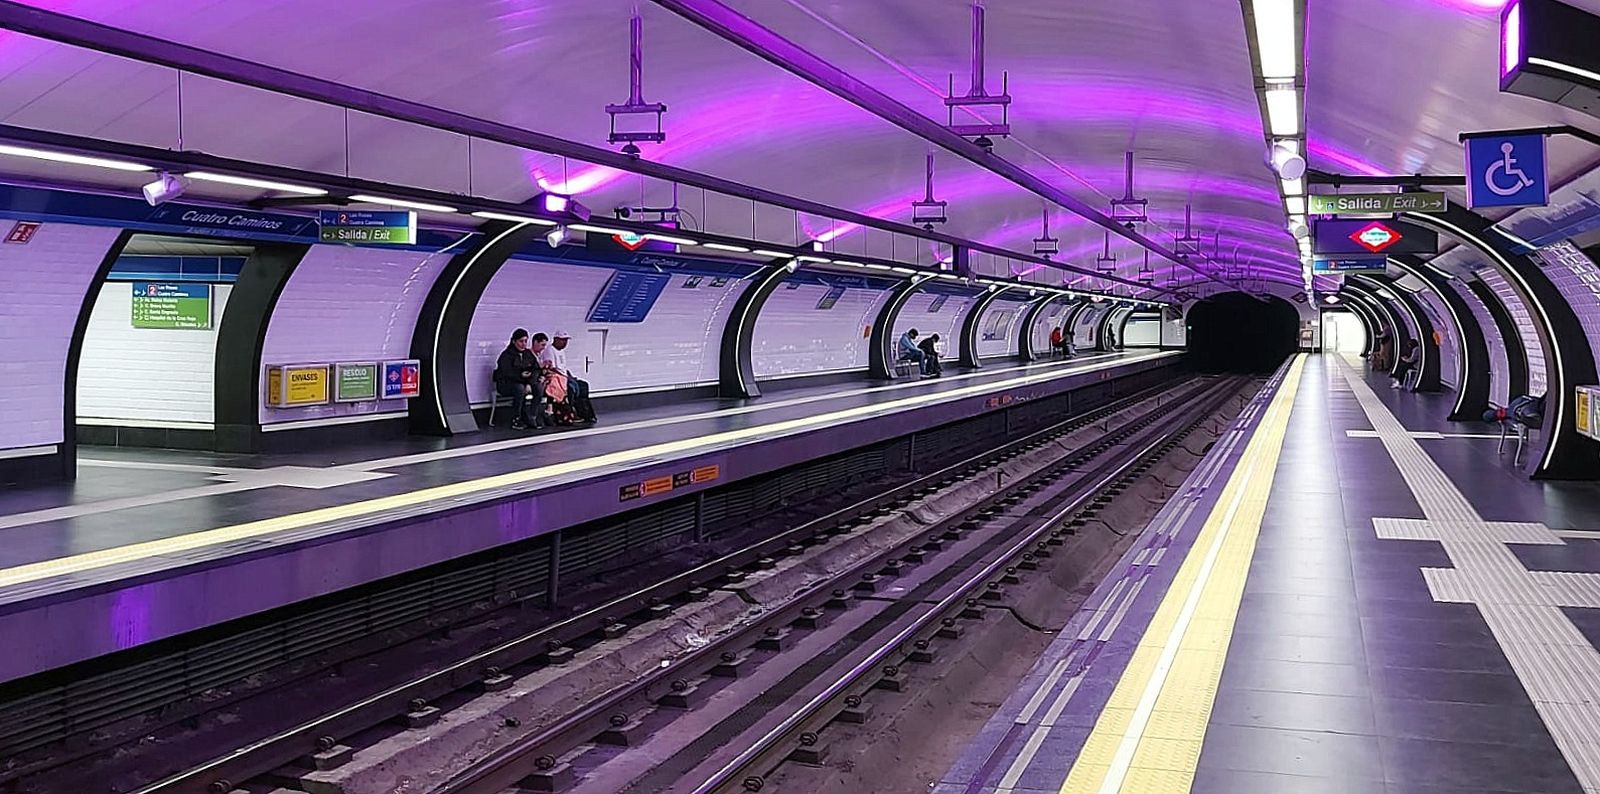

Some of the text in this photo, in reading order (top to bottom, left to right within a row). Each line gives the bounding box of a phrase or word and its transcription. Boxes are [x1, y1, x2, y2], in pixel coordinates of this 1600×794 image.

[1338, 197, 1381, 209] Salida
[1393, 196, 1416, 209] Exit
[181, 210, 283, 229] Cuatro Caminos
[340, 214, 346, 223] 2
[338, 229, 367, 240] Salida
[374, 229, 391, 240] Exit
[291, 373, 318, 382] ENVASES
